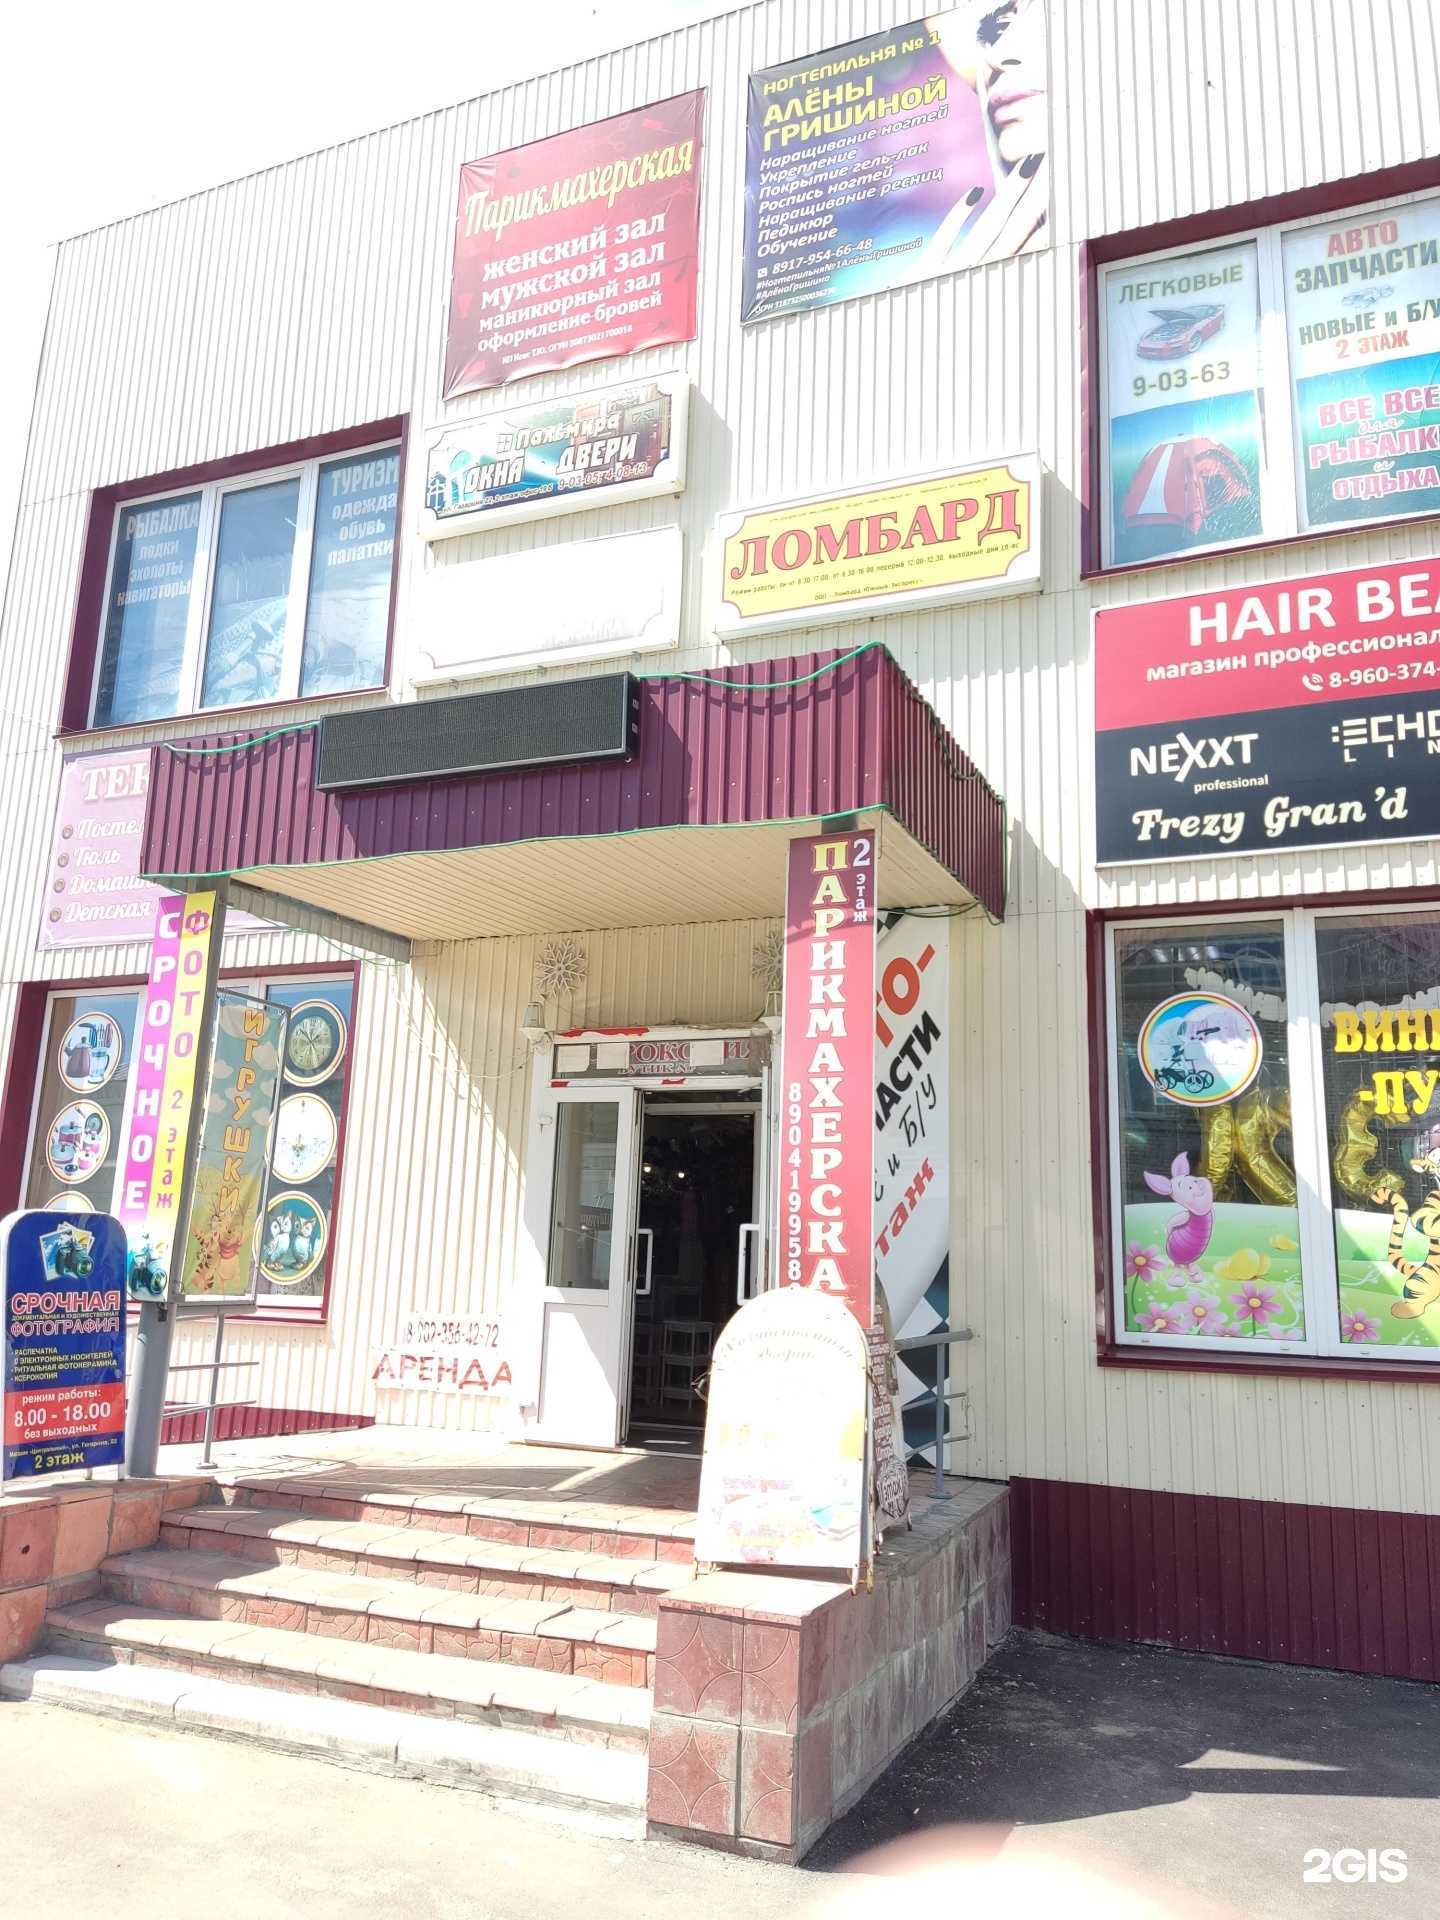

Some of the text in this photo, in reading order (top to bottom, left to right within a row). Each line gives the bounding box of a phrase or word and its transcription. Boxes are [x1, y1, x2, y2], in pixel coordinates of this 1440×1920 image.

[763, 30, 941, 96] НОГТЕПИЛЬНЯ № 1
[763, 75, 874, 127] АЛЁНЫ
[763, 74, 947, 152] ГРИШИНОЙ
[760, 104, 949, 171] Наращивание ногтей
[759, 142, 930, 199] Покрытие гель-лак
[760, 149, 857, 186] Укрепление
[465, 138, 694, 241] Парикмахерская
[758, 168, 944, 228] Наращивание ресниц
[759, 166, 894, 214] Роспись ногтей
[482, 212, 666, 282] женский зал
[757, 228, 839, 258] Обучение
[758, 214, 834, 244] Педикюр
[1327, 219, 1398, 258] АВТО
[771, 238, 873, 275] 8917-954-66-48
[1294, 239, 1439, 294] ЗАПЧАСТИ
[481, 241, 666, 311] мужской зал
[1119, 263, 1243, 304] ЛЕГКОВЫЕ
[479, 271, 661, 333] маникюрный зал
[478, 291, 662, 352] оформление бровей
[1299, 311, 1375, 346] НОВЫЕ
[1385, 311, 1398, 326] и
[1336, 330, 1409, 360] 2 ЭТАЖ
[1133, 361, 1231, 398] 9-03-63
[1318, 397, 1372, 428] ВСЕ
[464, 433, 638, 494] ОКНА ДВЕРИ
[1308, 425, 1440, 470] РЫБАЛК
[331, 455, 400, 497] ТУРИЗМ
[1332, 465, 1440, 500] ОТДЫХА
[126, 501, 200, 540] РЫБАЛКА
[332, 492, 397, 520] одежда
[339, 519, 386, 541] обувь
[730, 489, 1022, 581] ЛОМБАРД
[328, 539, 394, 566] палатки
[117, 580, 191, 606] навигаторы
[1189, 572, 1440, 647] HAIR BE
[1147, 654, 1247, 682] магазин
[1131, 731, 1259, 783] NEXXT
[1194, 774, 1269, 794] professional
[1132, 808, 1246, 844] Frezy
[73, 846, 121, 867] Тюль
[853, 838, 871, 922] 2 этаж
[64, 900, 152, 924] Детская
[126, 912, 181, 1209] СРОЧНОЕ
[156, 909, 211, 1210] ФОТО 2 этаж
[219, 1009, 267, 1213] ИГРУШКИ
[788, 1082, 802, 1288] 890419958
[11, 1290, 120, 1315] СРОЧНАЯ
[10, 1317, 120, 1337] ФОТОГРАФИЯ
[14, 1347, 58, 1356] РАСПЕЧАТКА
[14, 1359, 118, 1374] РИТУАЛЬНАЯ ФОТОКЕРАМИКА
[19, 1354, 69, 1365] ЭЛЕКТРОННЫХ
[70, 1350, 113, 1361] НОСИТЕЛЕЙ
[14, 1372, 58, 1382] КСЕРОКОПИЯ
[371, 1353, 512, 1391] АРЕНДА
[14, 1408, 47, 1428] 8.00
[63, 1402, 112, 1422] 18.00
[22, 1388, 102, 1407] режим работы:
[24, 1423, 98, 1440] без выходных
[35, 1451, 85, 1470] 2 этаж
